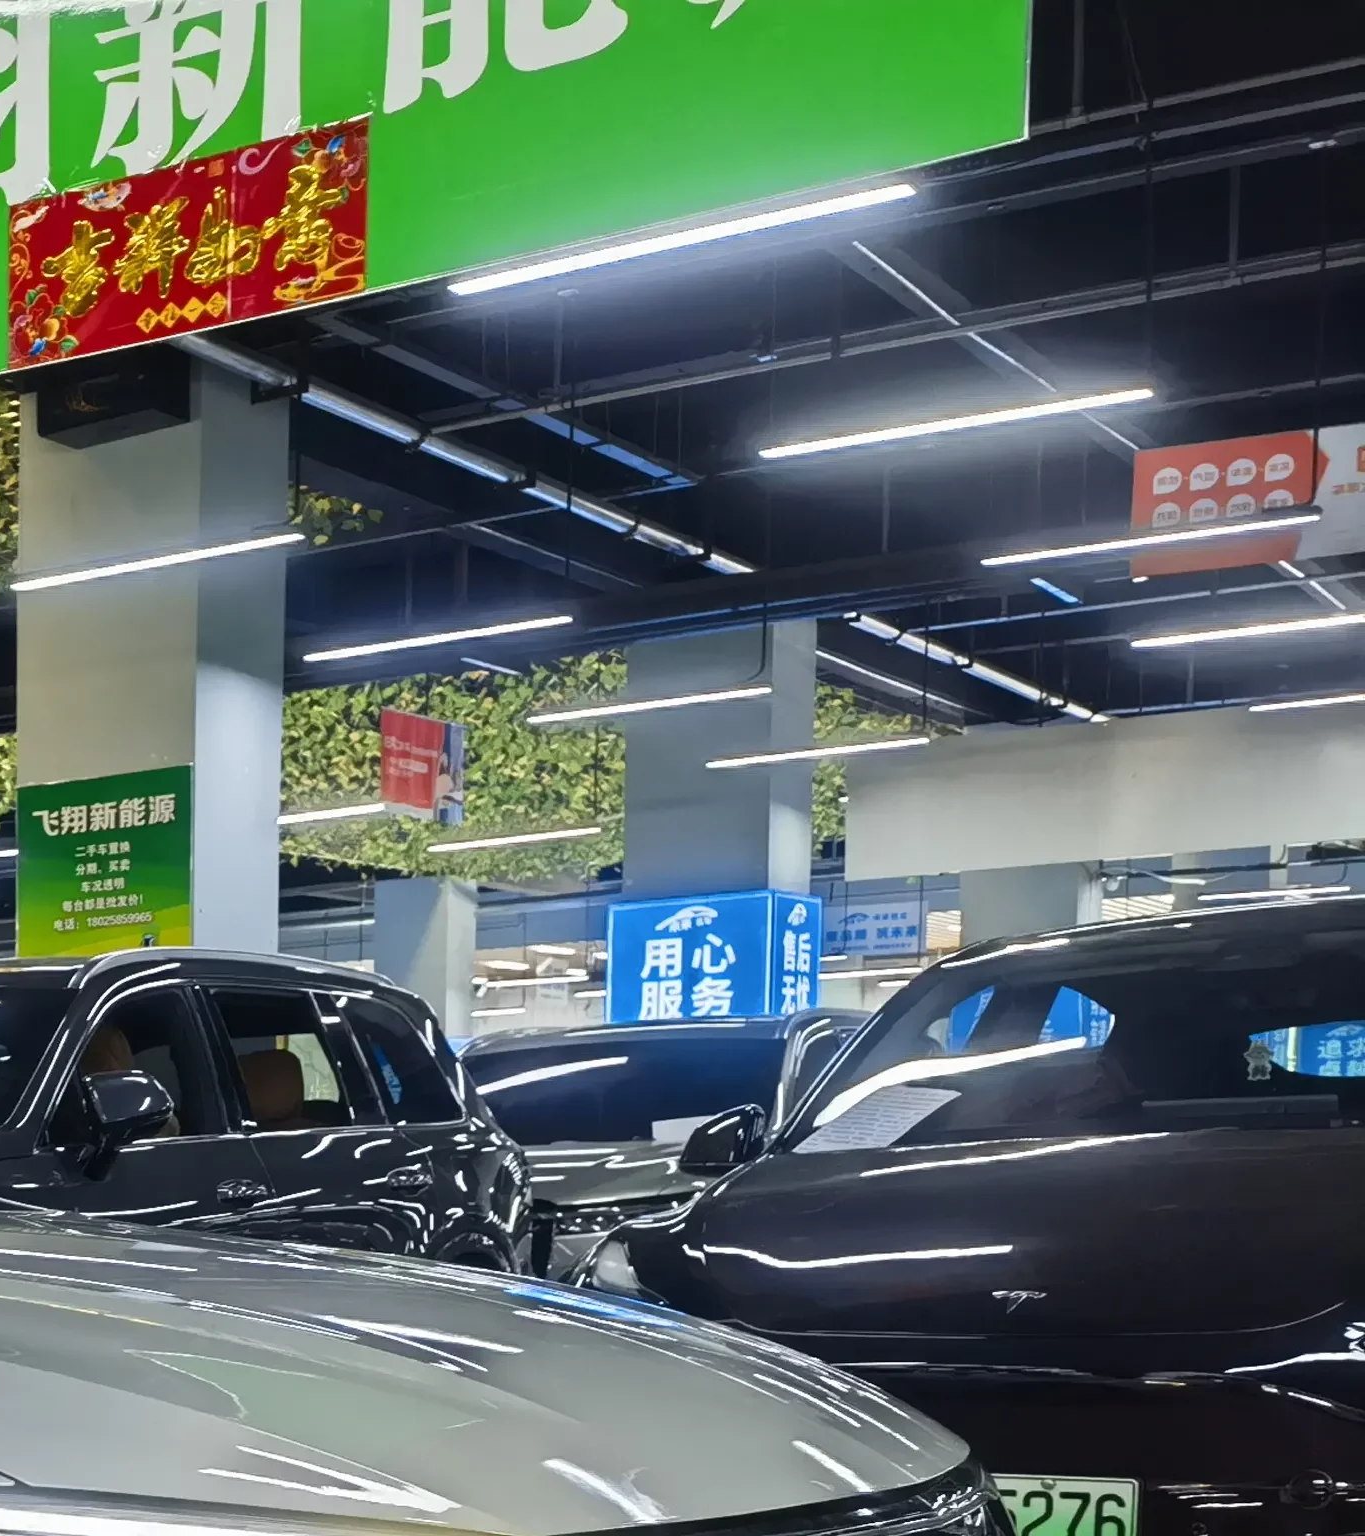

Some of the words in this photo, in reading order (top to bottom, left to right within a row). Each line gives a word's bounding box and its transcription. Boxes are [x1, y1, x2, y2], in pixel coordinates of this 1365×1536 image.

[32, 793, 176, 837] 飞翔新能源
[75, 841, 131, 858] 二手车置换
[81, 877, 126, 894] 车况透明
[640, 933, 736, 979] 用心
[783, 930, 812, 973] 售后
[638, 977, 735, 1021] 服务
